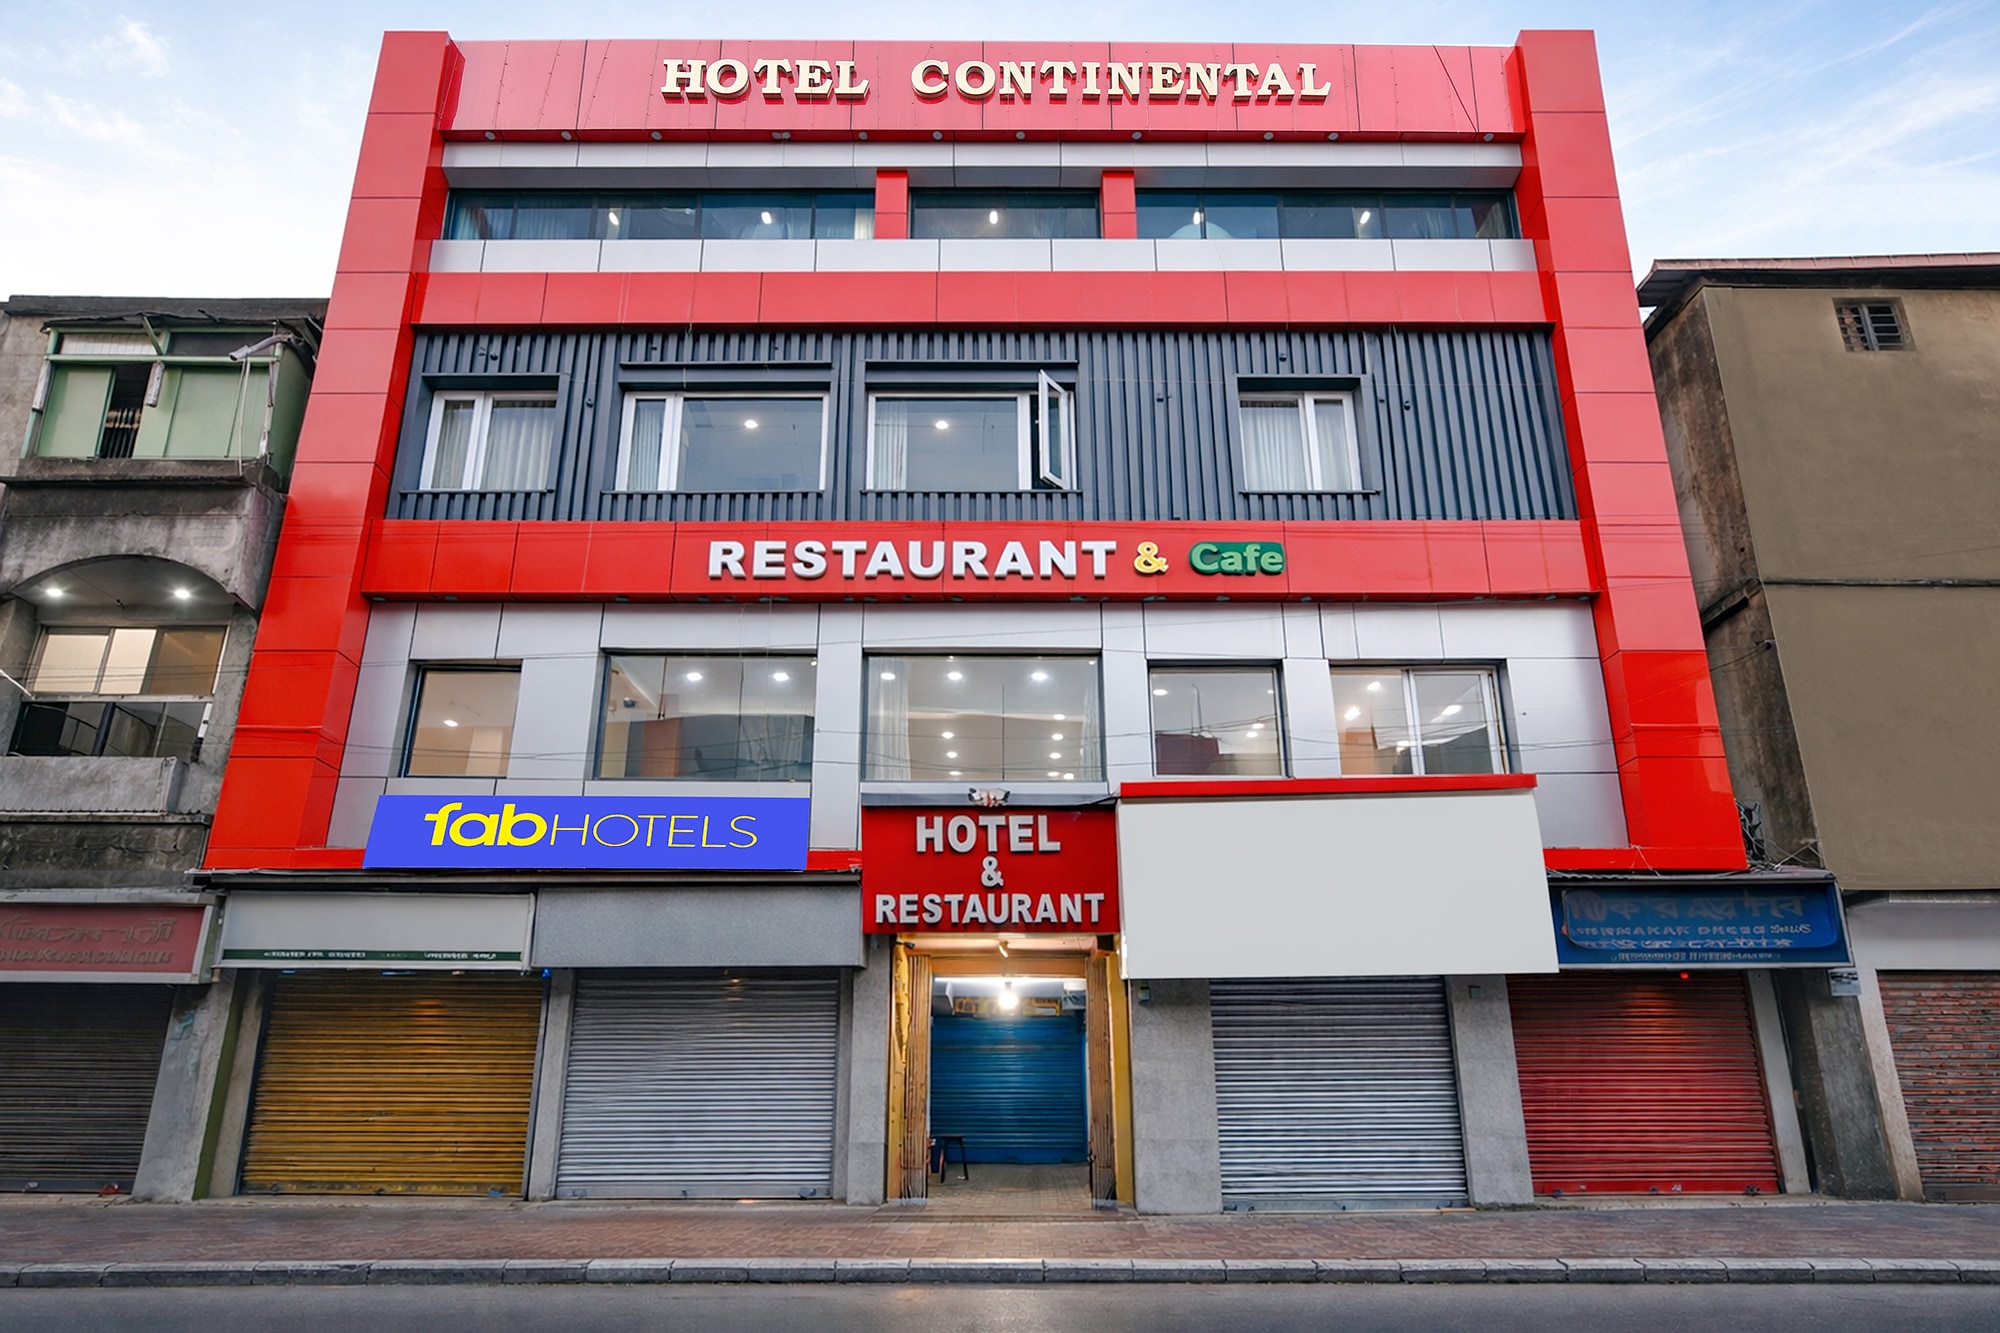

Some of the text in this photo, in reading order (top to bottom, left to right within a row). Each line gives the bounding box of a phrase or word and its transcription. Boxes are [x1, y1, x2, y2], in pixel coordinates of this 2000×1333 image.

[661, 59, 1332, 101] HOTEL CONTINENTAL
[708, 540, 1285, 579] RESTAURANT & Cafe
[916, 814, 1061, 853] HOTEL
[981, 856, 1004, 887] &
[875, 892, 1105, 924] RESTAURANT
